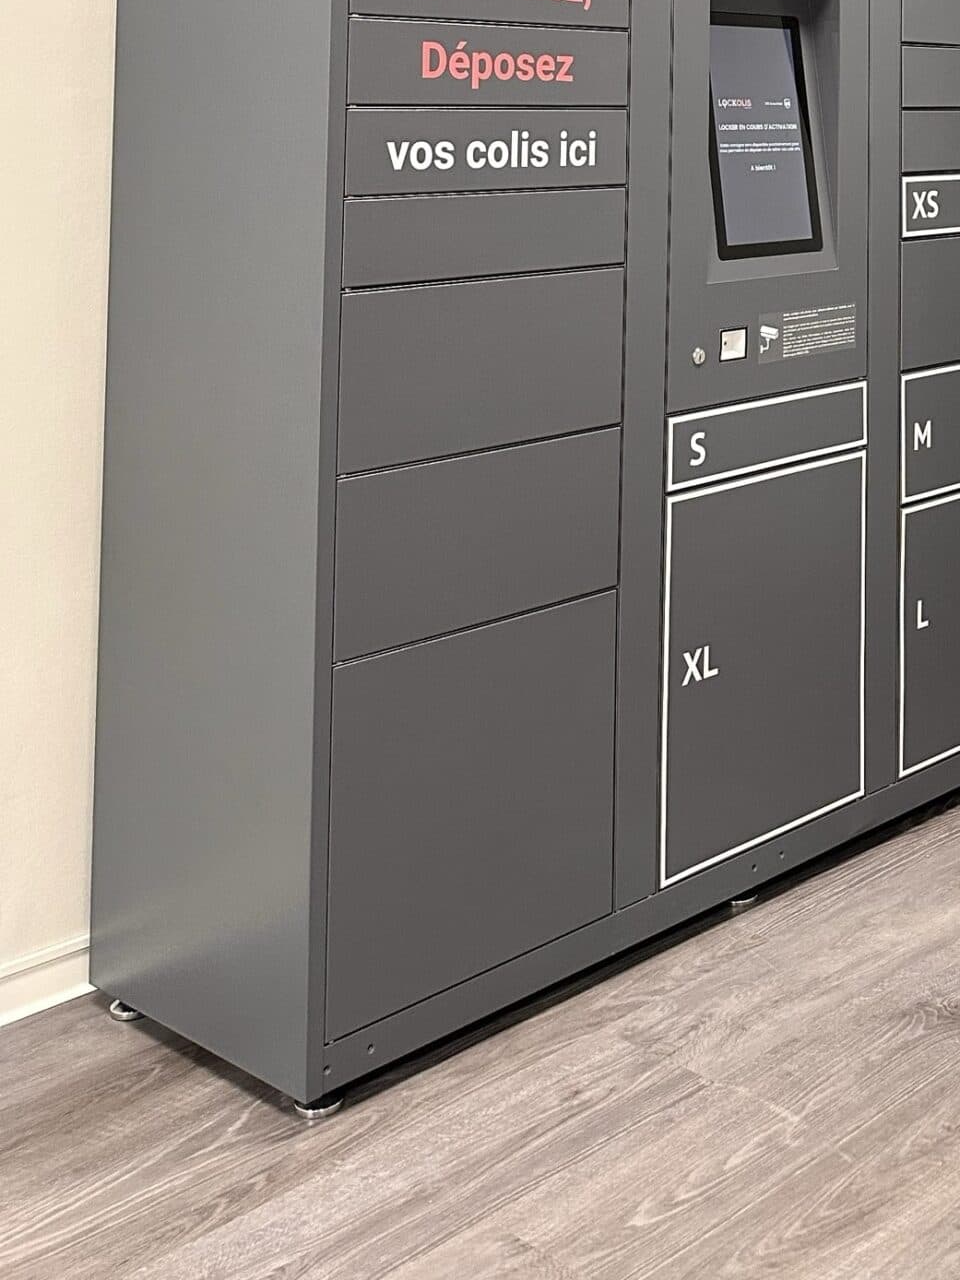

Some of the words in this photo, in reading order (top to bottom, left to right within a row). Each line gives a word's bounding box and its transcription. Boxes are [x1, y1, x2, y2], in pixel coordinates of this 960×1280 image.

[421, 40, 575, 90] Déposez
[386, 140, 454, 171] vos
[466, 129, 549, 170] colis
[559, 129, 596, 167] ici
[912, 190, 939, 220] XS
[689, 431, 706, 466] S
[913, 420, 932, 451] M
[916, 600, 929, 630] L
[682, 645, 719, 687] XL
